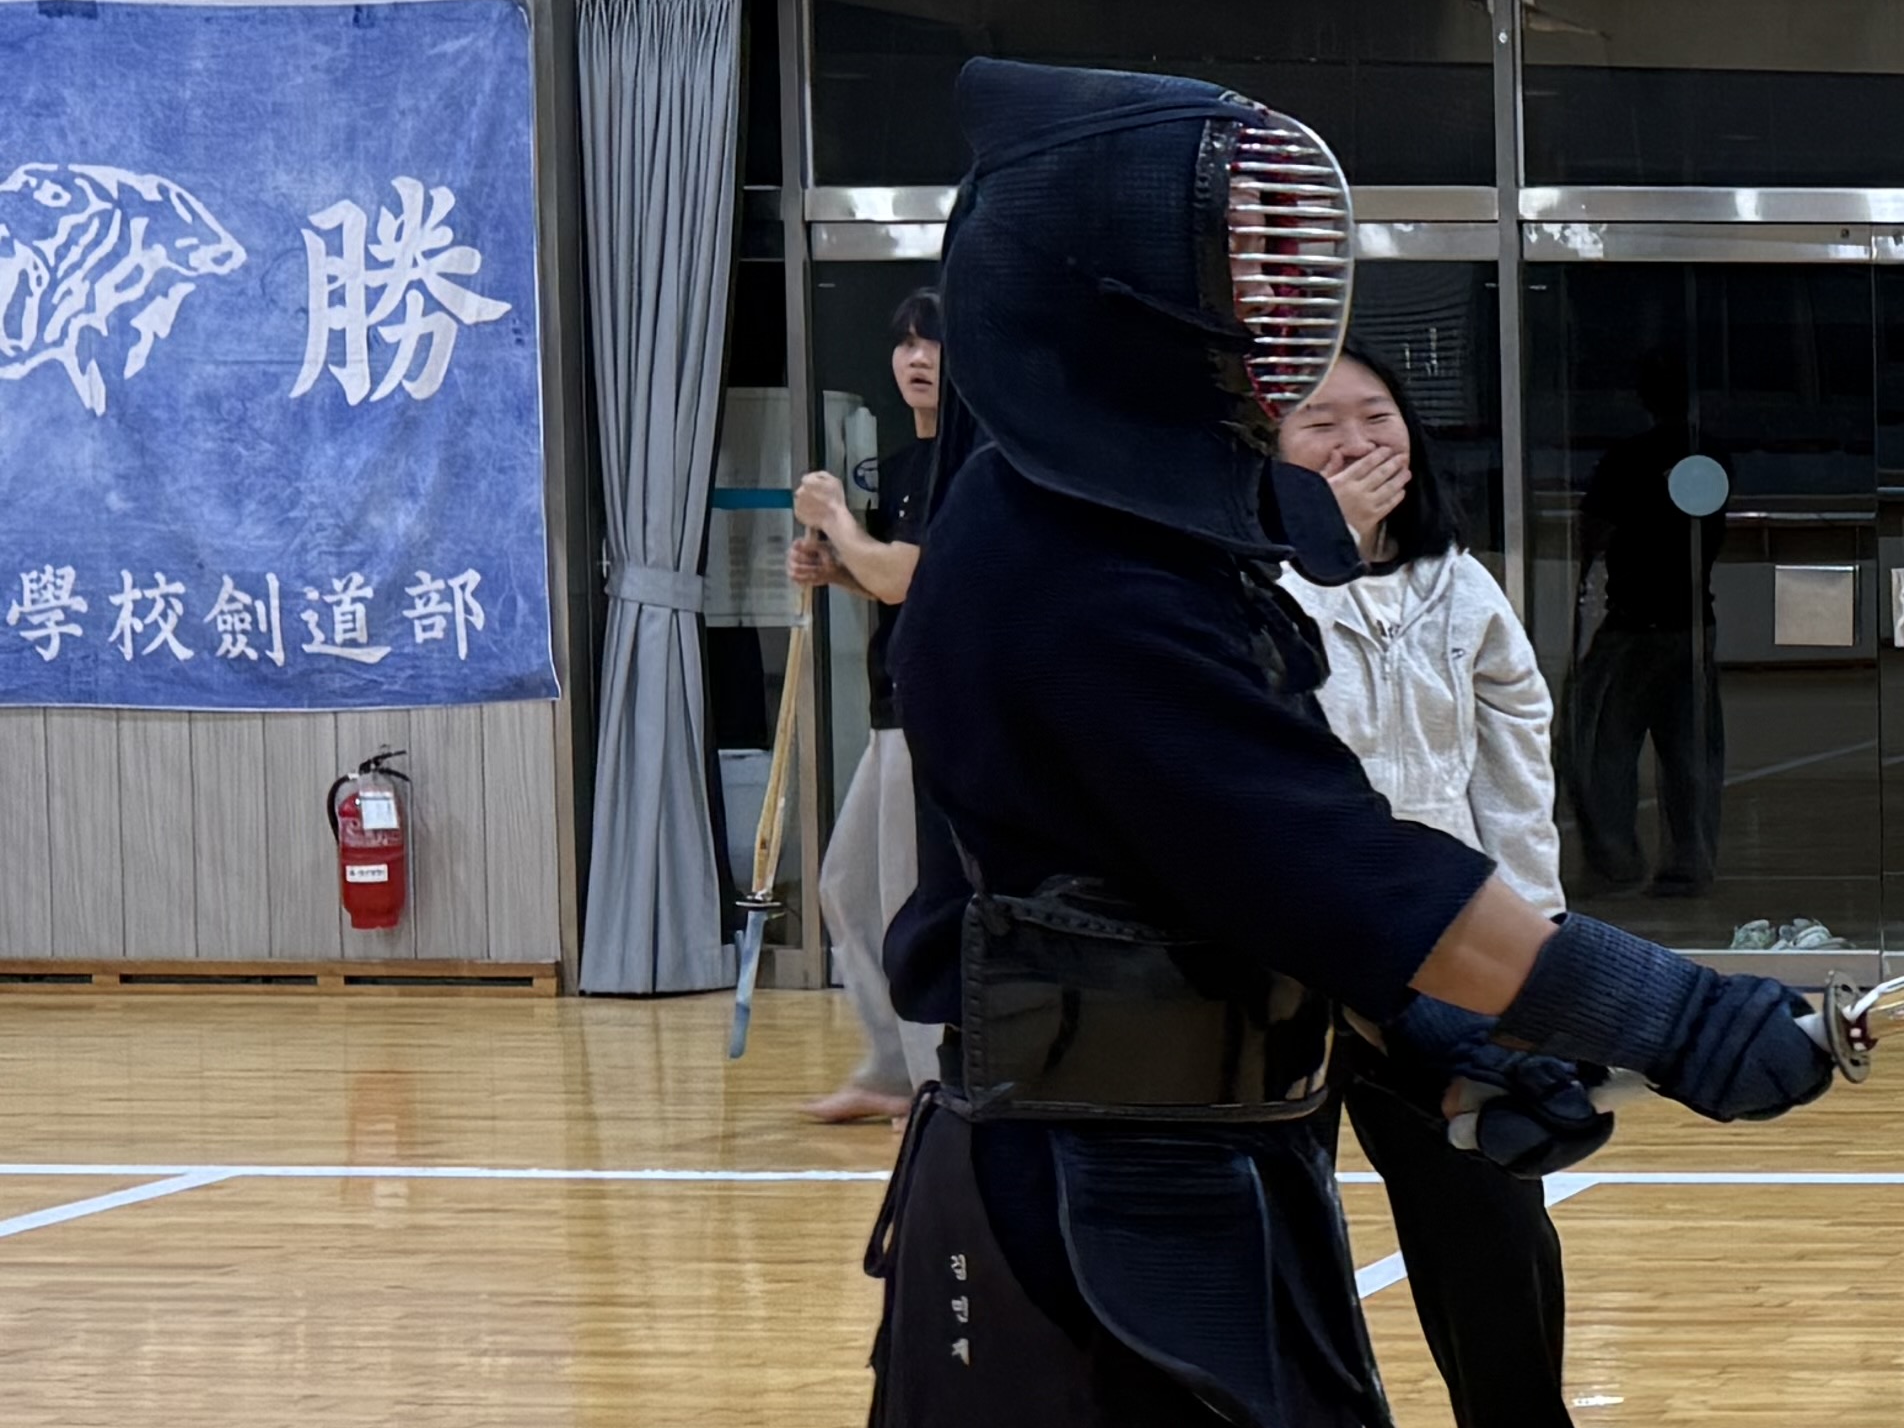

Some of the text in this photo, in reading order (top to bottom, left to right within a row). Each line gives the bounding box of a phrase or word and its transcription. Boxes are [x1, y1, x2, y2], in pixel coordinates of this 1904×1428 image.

[288, 176, 512, 406] 勝
[5, 564, 486, 667] 學校劍道部
